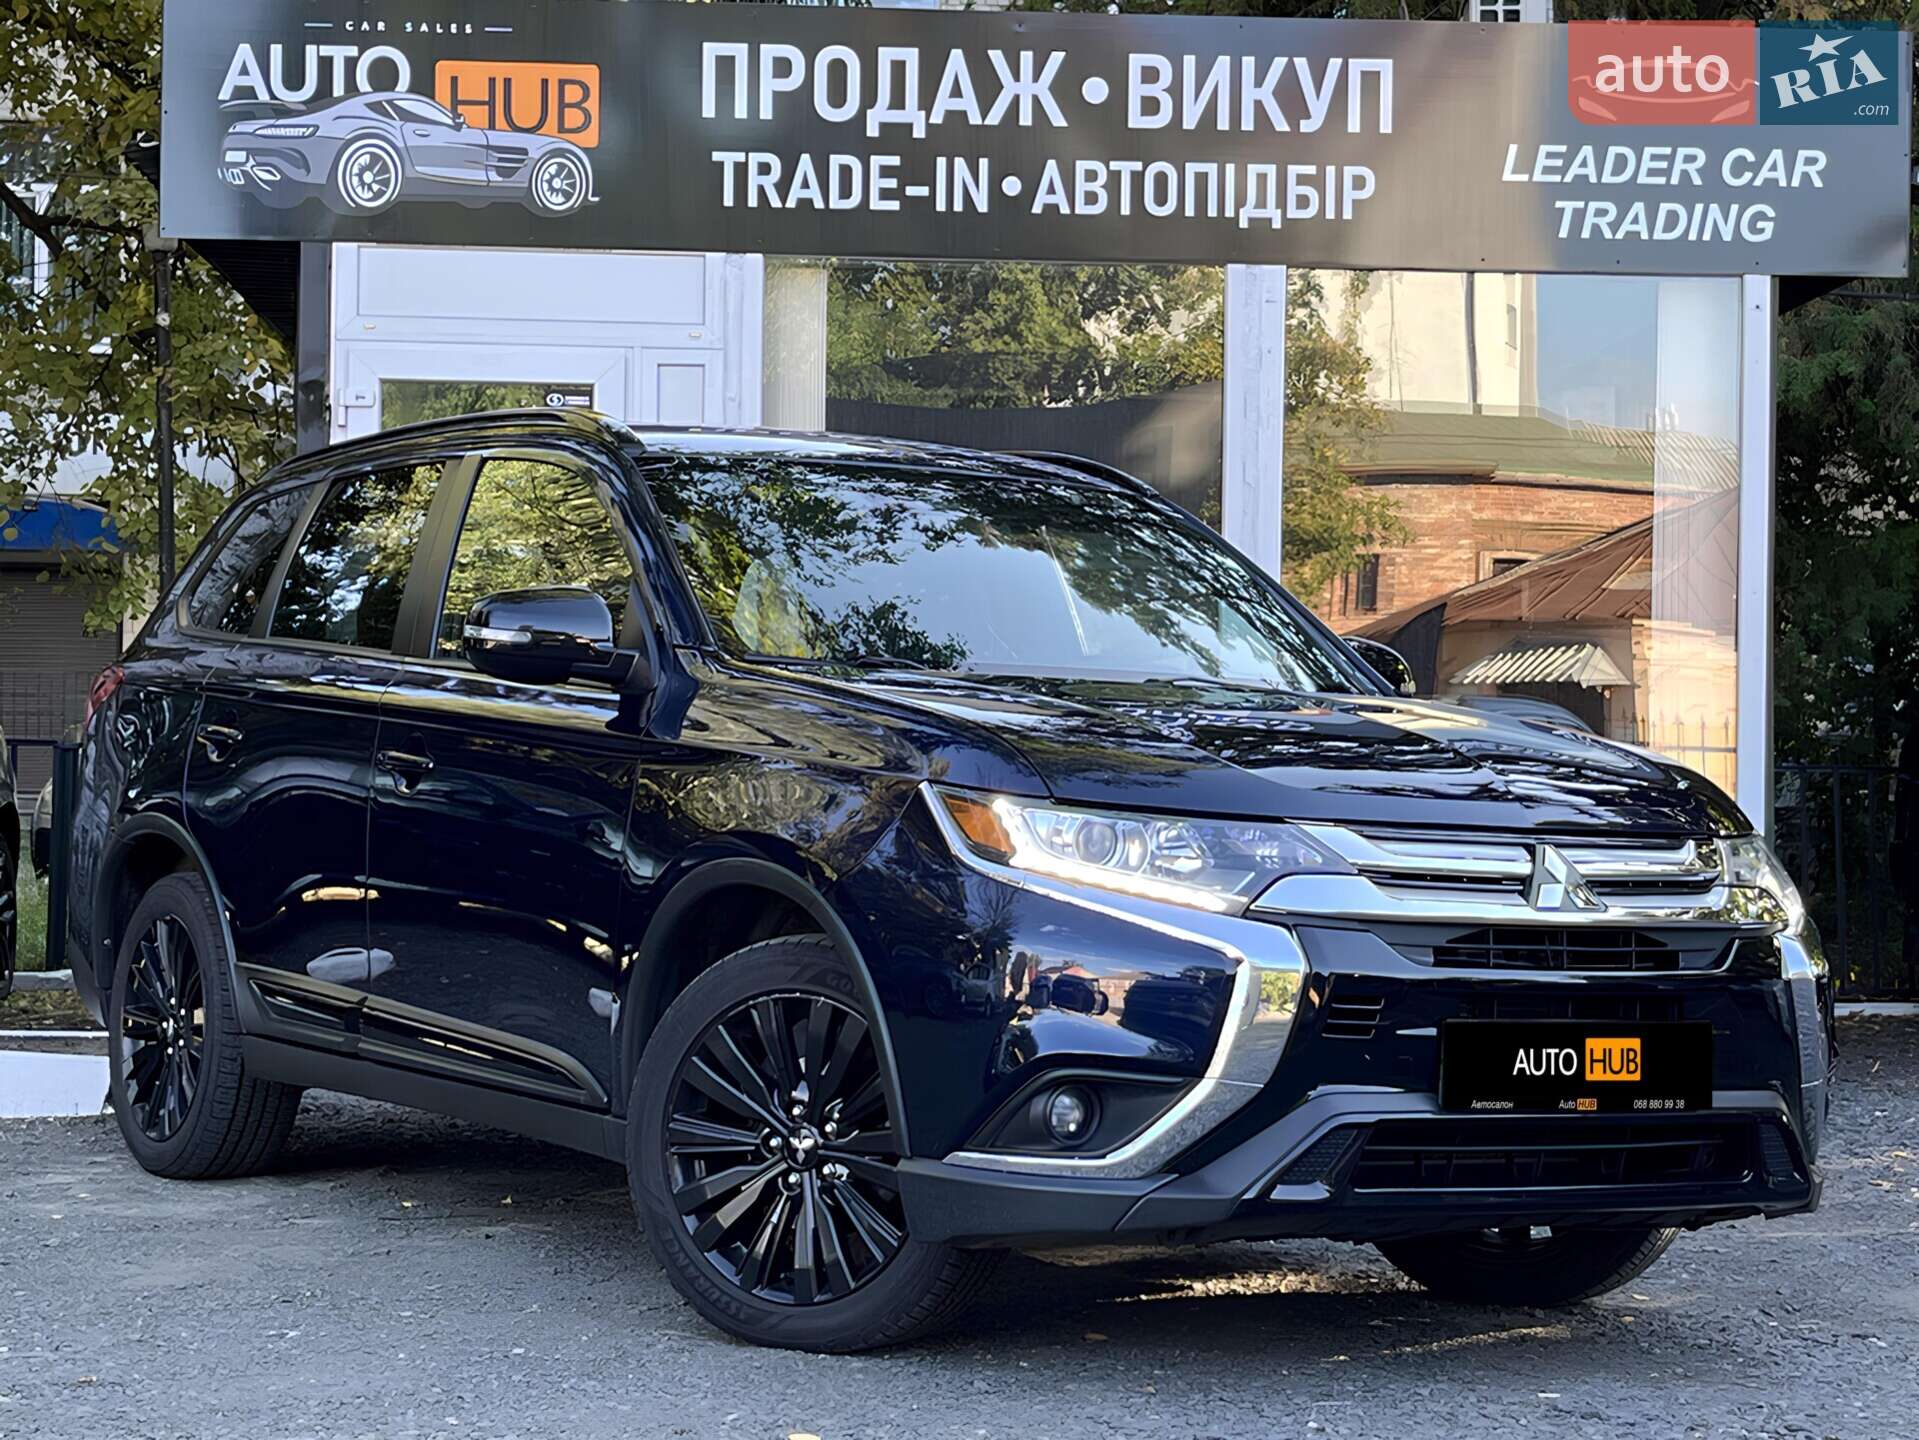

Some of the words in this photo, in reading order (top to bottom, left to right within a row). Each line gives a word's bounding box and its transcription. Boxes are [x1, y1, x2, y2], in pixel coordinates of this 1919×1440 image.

[345, 21, 386, 31] CAR
[405, 22, 473, 34] SALES
[217, 43, 412, 102] AUTO
[450, 76, 592, 133] HUB
[702, 41, 1068, 138] ПРОДАЖ
[1128, 53, 1393, 134] ВИКУП
[1501, 143, 1706, 186] LEADER
[1721, 148, 1827, 188] CAR
[712, 152, 988, 212] TRADE-IN
[1032, 159, 1375, 228] АВТОПІДБІР
[1555, 201, 1776, 242] TRADING
[1513, 1048, 1578, 1075] AUTO
[1589, 1047, 1639, 1075] HUB
[1558, 1100, 1576, 1109] Auto
[1578, 1100, 1596, 1109] HUB
